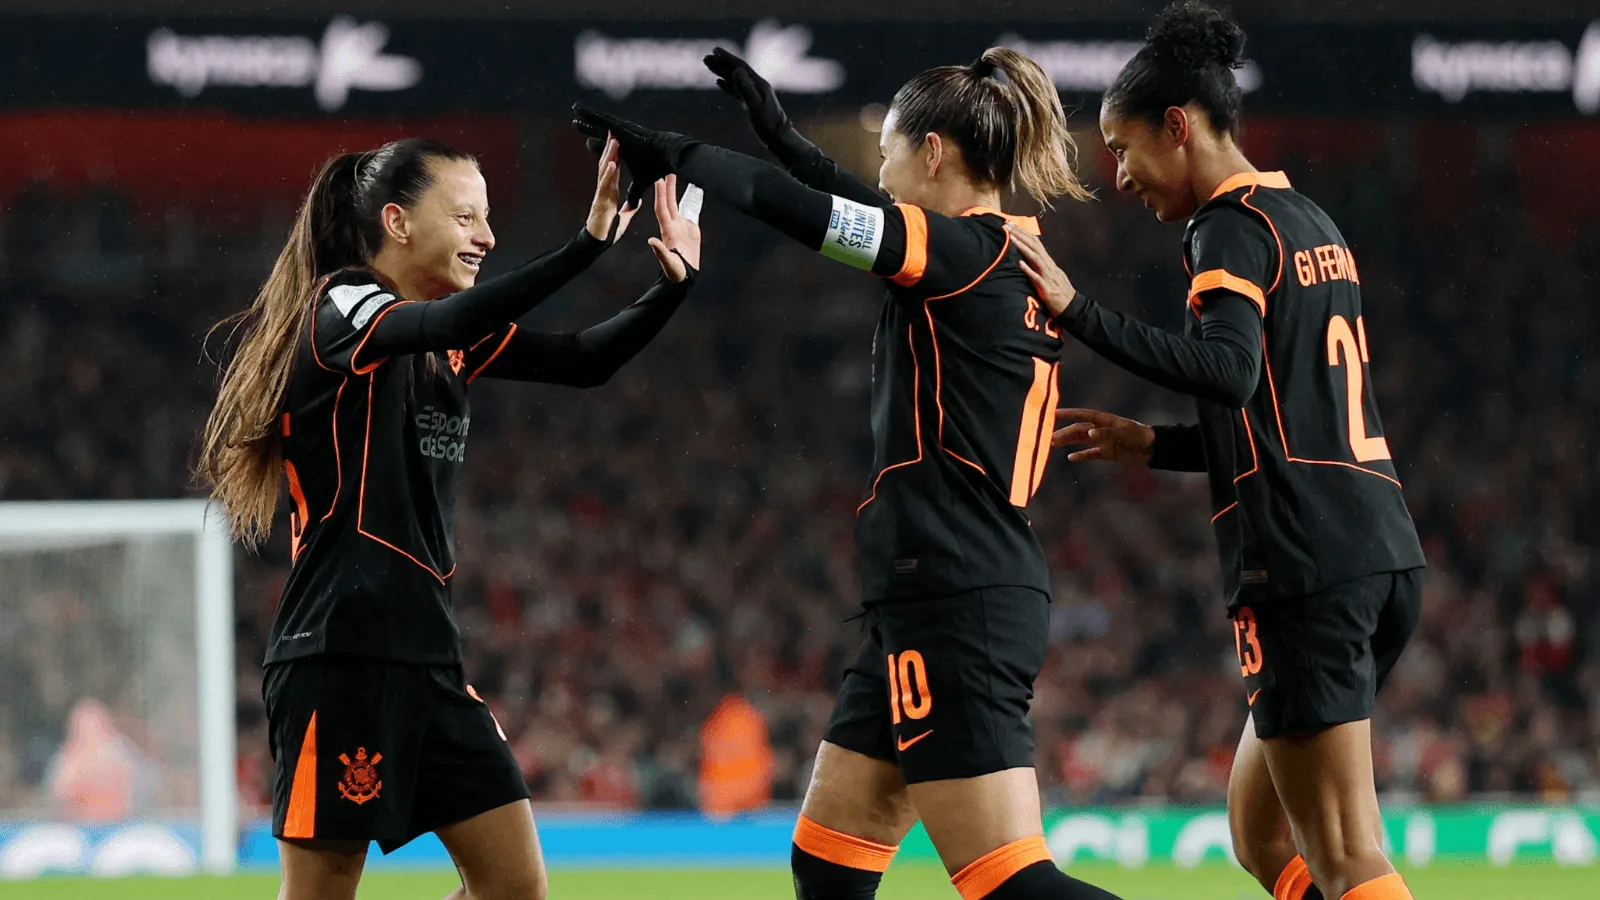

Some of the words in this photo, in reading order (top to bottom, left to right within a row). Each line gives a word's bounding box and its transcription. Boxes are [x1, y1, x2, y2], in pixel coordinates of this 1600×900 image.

[830, 210, 840, 229] FIFA
[835, 216, 852, 247] World
[848, 208, 867, 248] UNITES
[861, 213, 876, 249] FOOTBALL
[1294, 250, 1317, 287] GI
[1327, 314, 1392, 463] 2
[887, 649, 932, 725] 10
